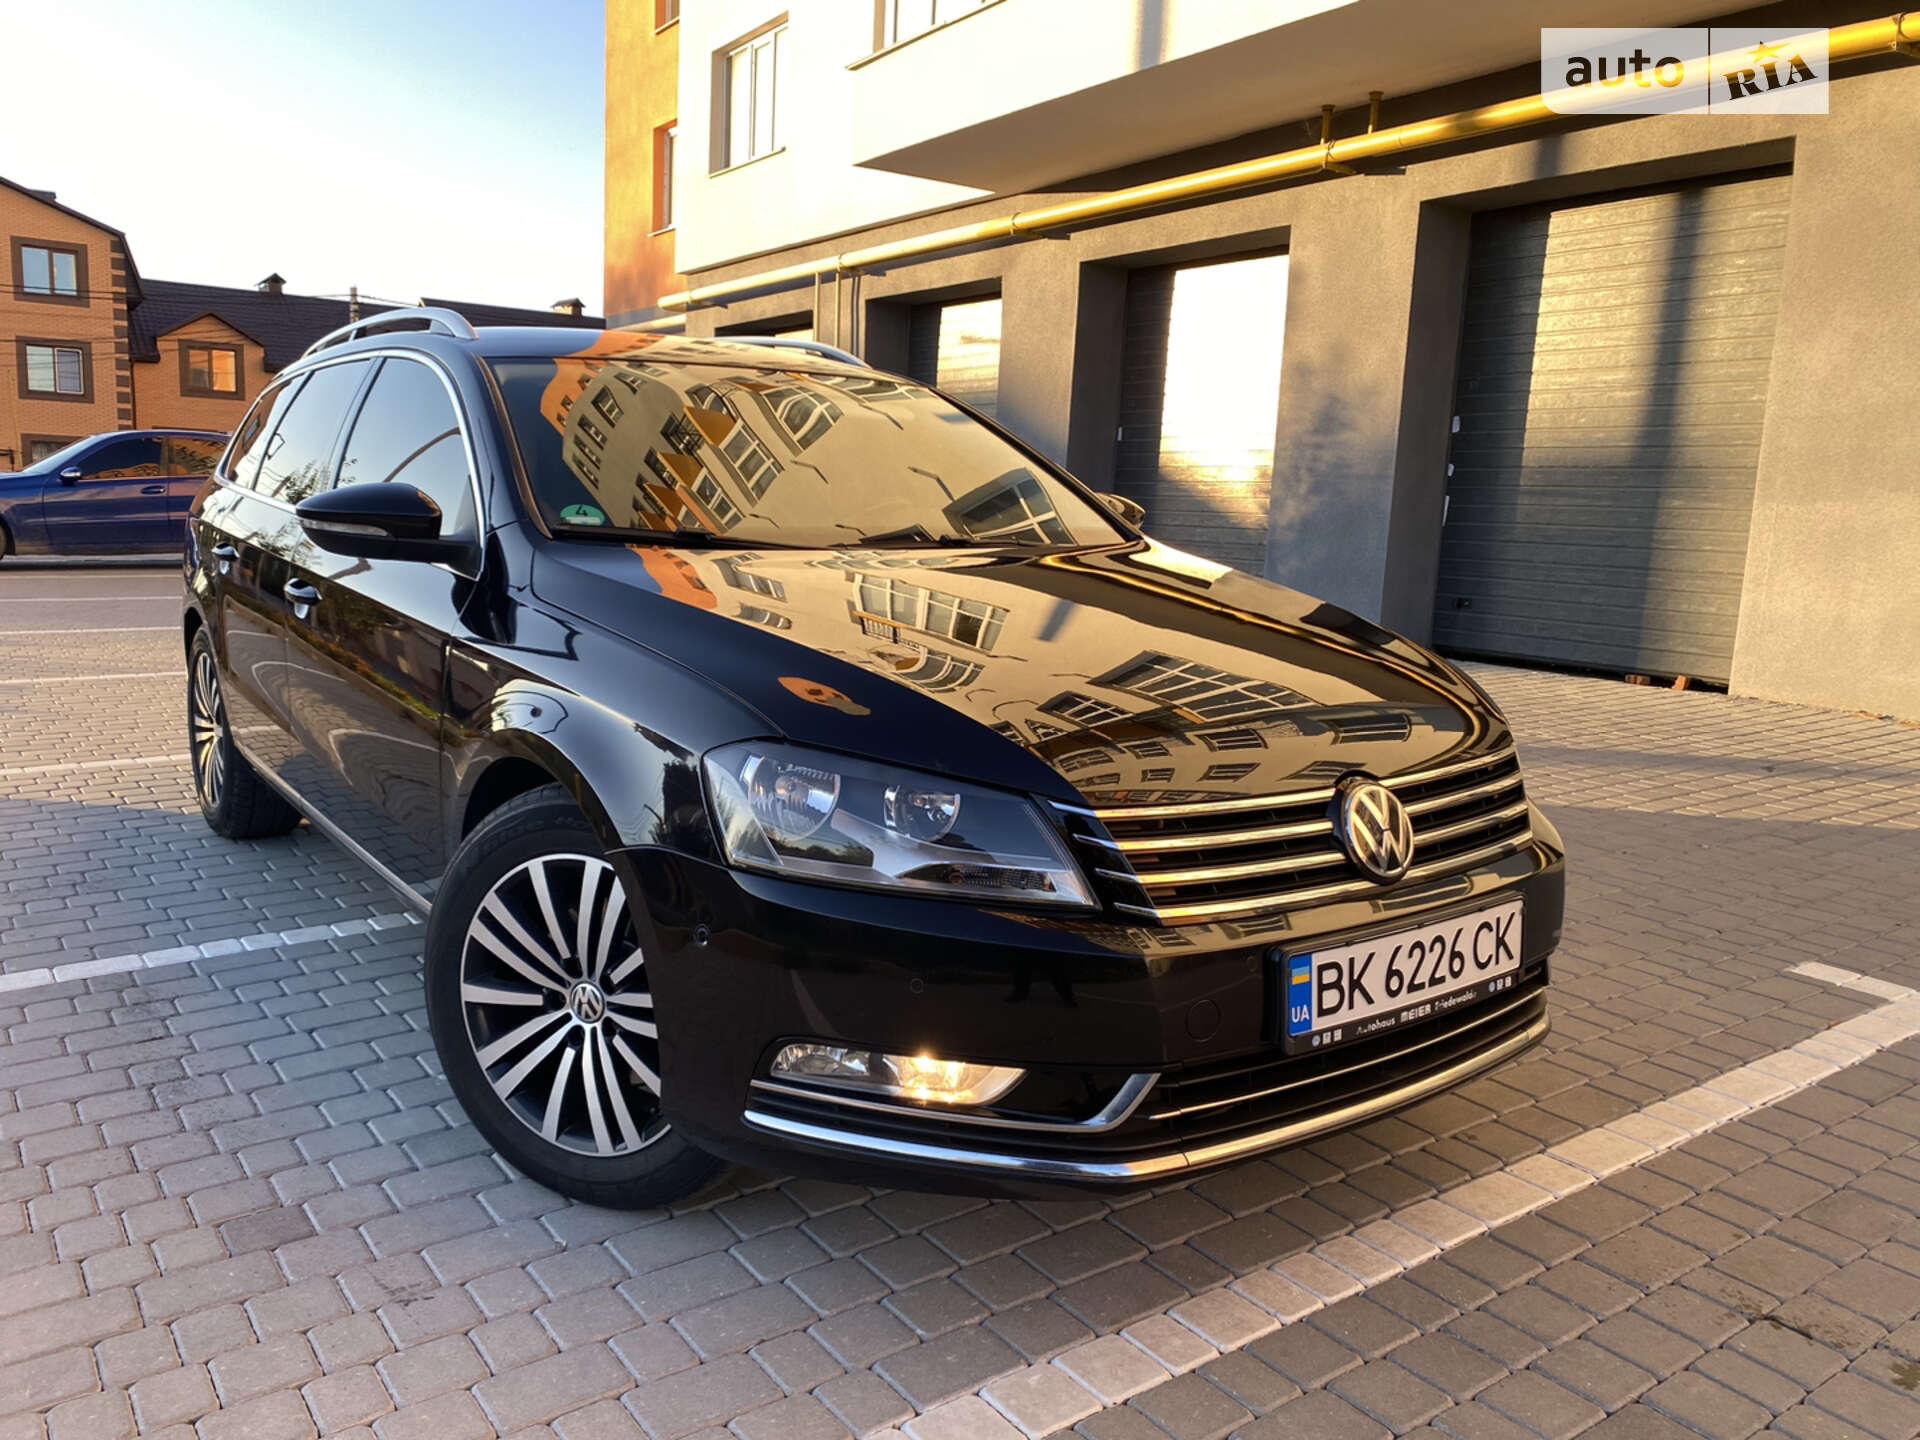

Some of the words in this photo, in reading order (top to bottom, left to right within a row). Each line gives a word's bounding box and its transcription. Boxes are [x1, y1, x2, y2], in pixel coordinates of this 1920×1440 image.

[576, 505, 588, 516] 4
[1316, 951, 1376, 1018] BK
[1384, 927, 1465, 998] 6226
[1473, 911, 1516, 970] CK
[1291, 1004, 1310, 1023] UA
[1400, 1004, 1432, 1023] MEIER
